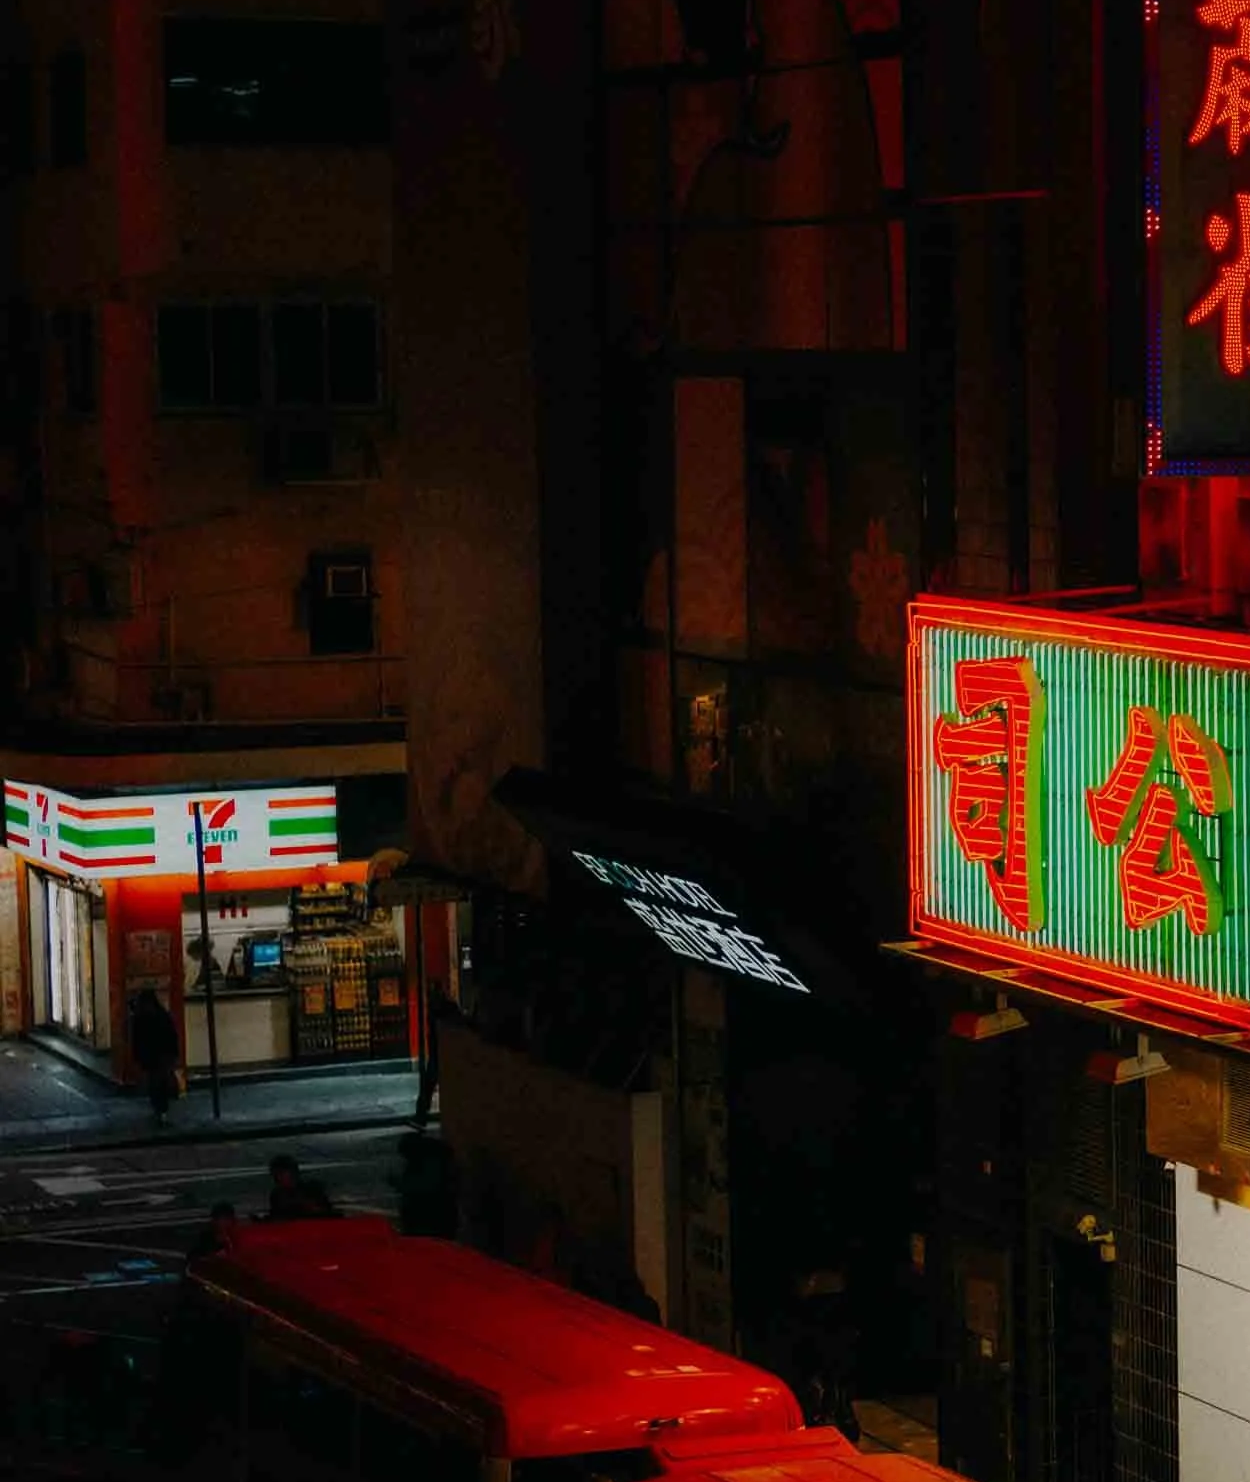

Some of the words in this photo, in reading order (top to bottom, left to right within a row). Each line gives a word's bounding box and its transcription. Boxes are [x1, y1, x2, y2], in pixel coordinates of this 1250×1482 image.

[656, 872, 738, 918] HOTEL
[623, 896, 812, 994] 盛世酒店
